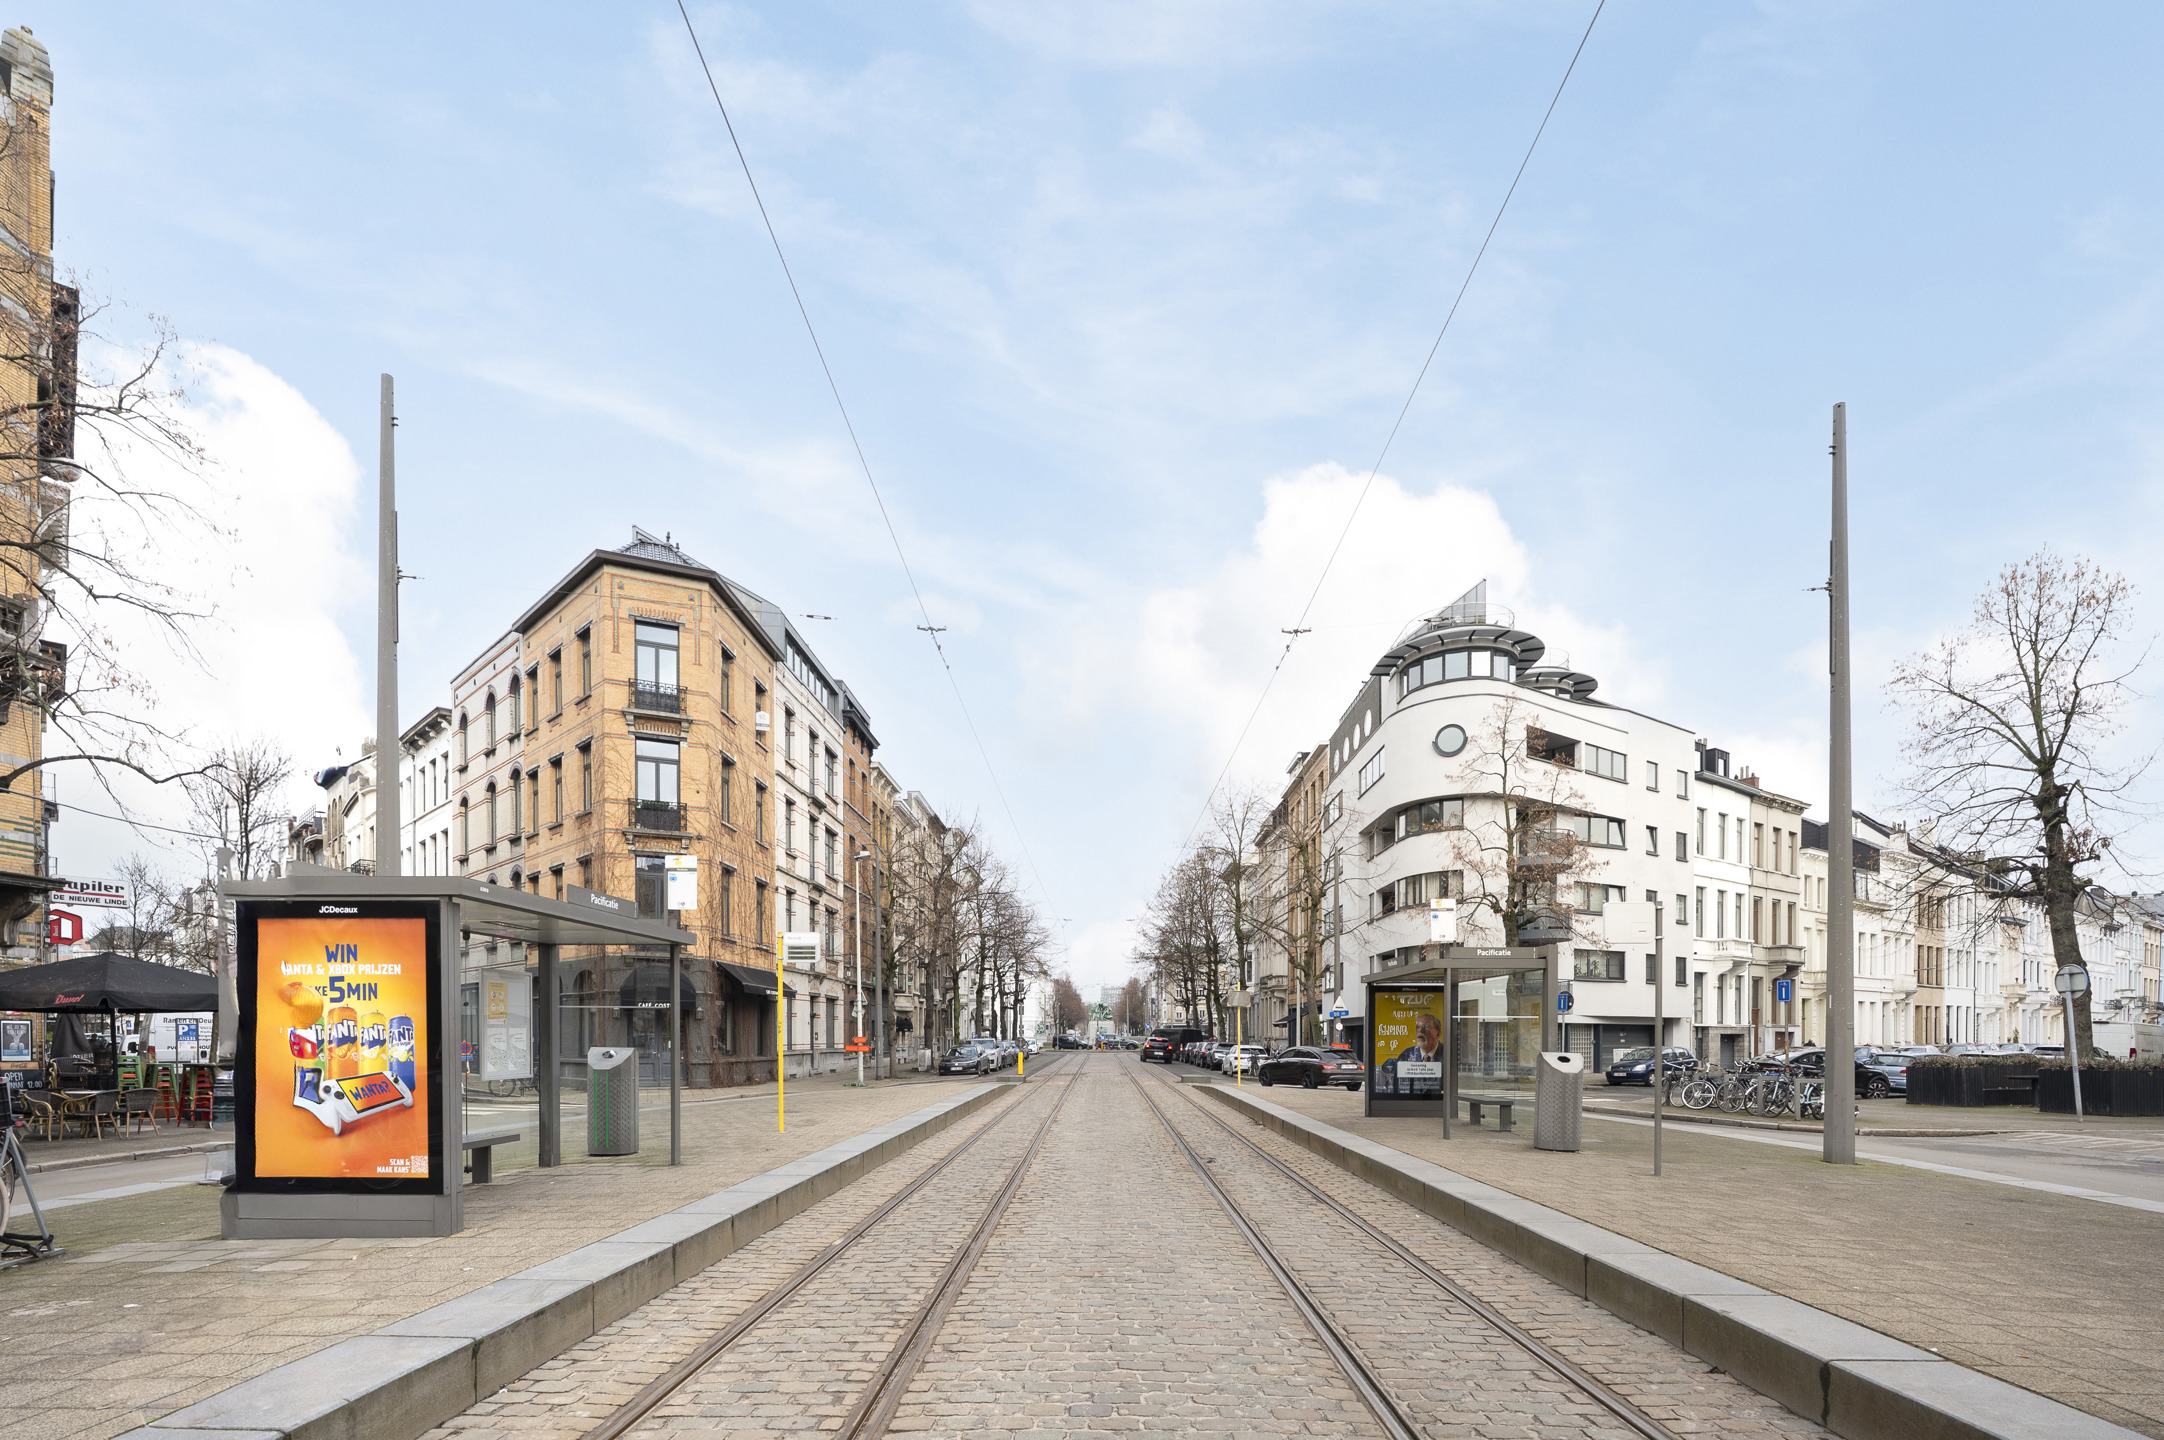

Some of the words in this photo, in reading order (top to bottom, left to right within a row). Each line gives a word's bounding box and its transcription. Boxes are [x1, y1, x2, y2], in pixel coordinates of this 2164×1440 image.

[67, 881, 125, 894] upiler
[68, 895, 101, 904] NIEUWE
[104, 898, 128, 906] LINDE
[591, 893, 618, 910] Pacificatie
[319, 905, 358, 914] JCDecaux
[325, 943, 358, 963] WIN
[1477, 948, 1512, 956] Pacificatie
[316, 964, 325, 975] &
[328, 963, 356, 975] XBOX
[358, 963, 402, 975] PRIJZEN
[329, 975, 345, 1003] 5
[347, 982, 378, 1001] MIN
[178, 1024, 189, 1036] P
[4, 1071, 24, 1081] OPEN
[349, 1081, 392, 1101] WANTA?
[389, 1158, 405, 1166] SCAN
[376, 1166, 393, 1174] MAAK
